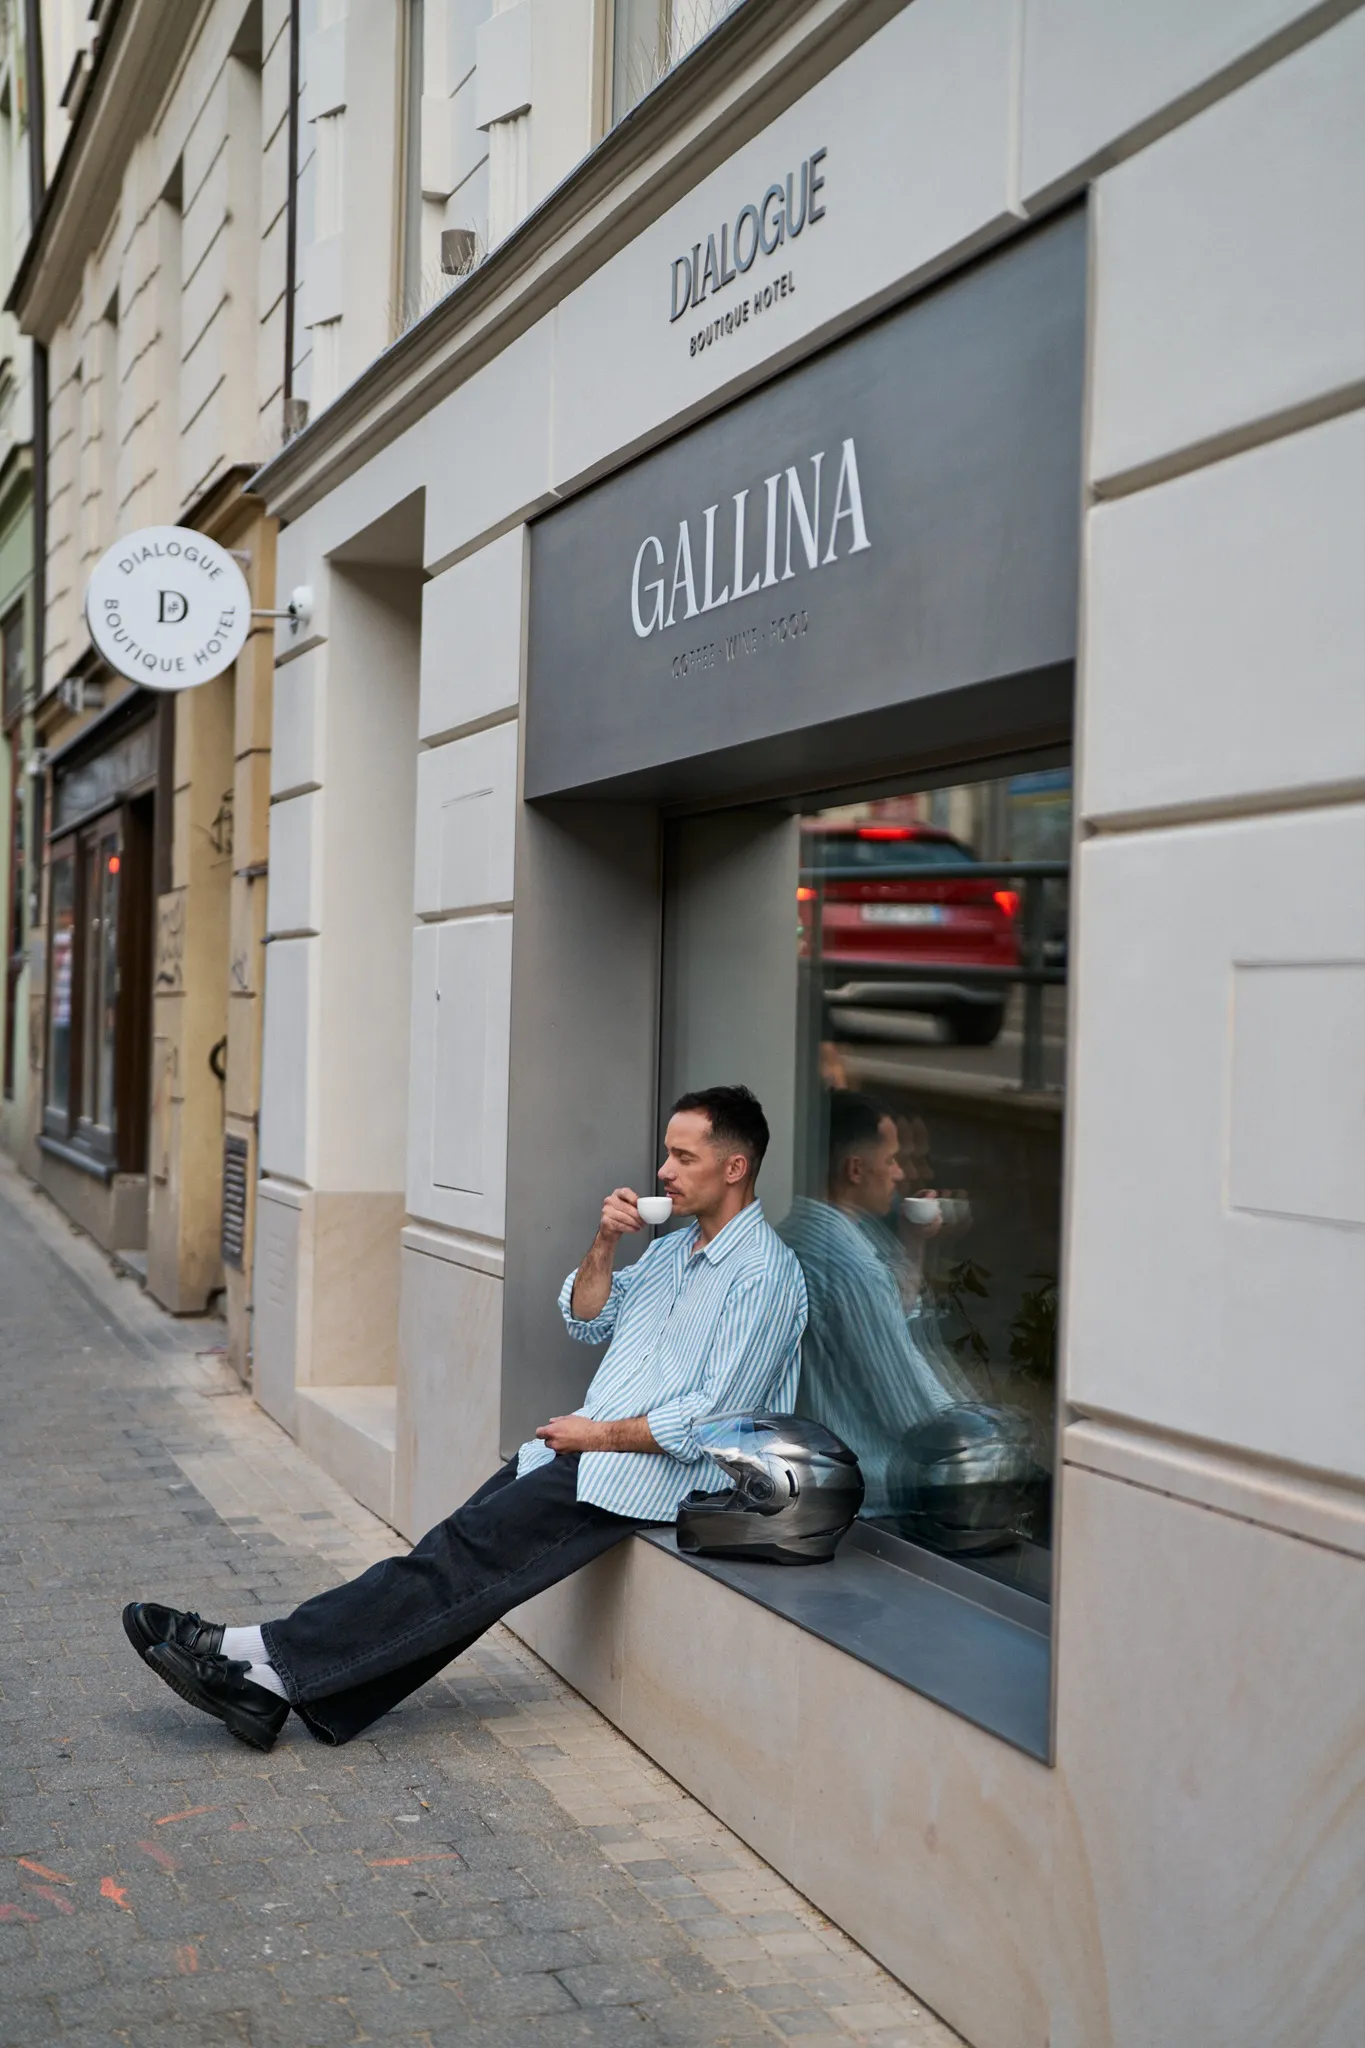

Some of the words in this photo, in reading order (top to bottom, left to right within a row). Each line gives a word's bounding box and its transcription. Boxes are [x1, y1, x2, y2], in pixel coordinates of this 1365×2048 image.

[670, 148, 827, 323] DIALOGUE
[689, 300, 749, 356] BOUTIQUE
[754, 271, 795, 315] HOTEL
[119, 542, 223, 580] DIALOGUE
[631, 438, 871, 638] GALLINA
[104, 600, 186, 672] BOUTIQUE
[194, 606, 236, 665] HOTEL
[672, 643, 714, 678] COFFEE
[725, 628, 757, 661] WINE
[769, 610, 808, 645] FOOD
